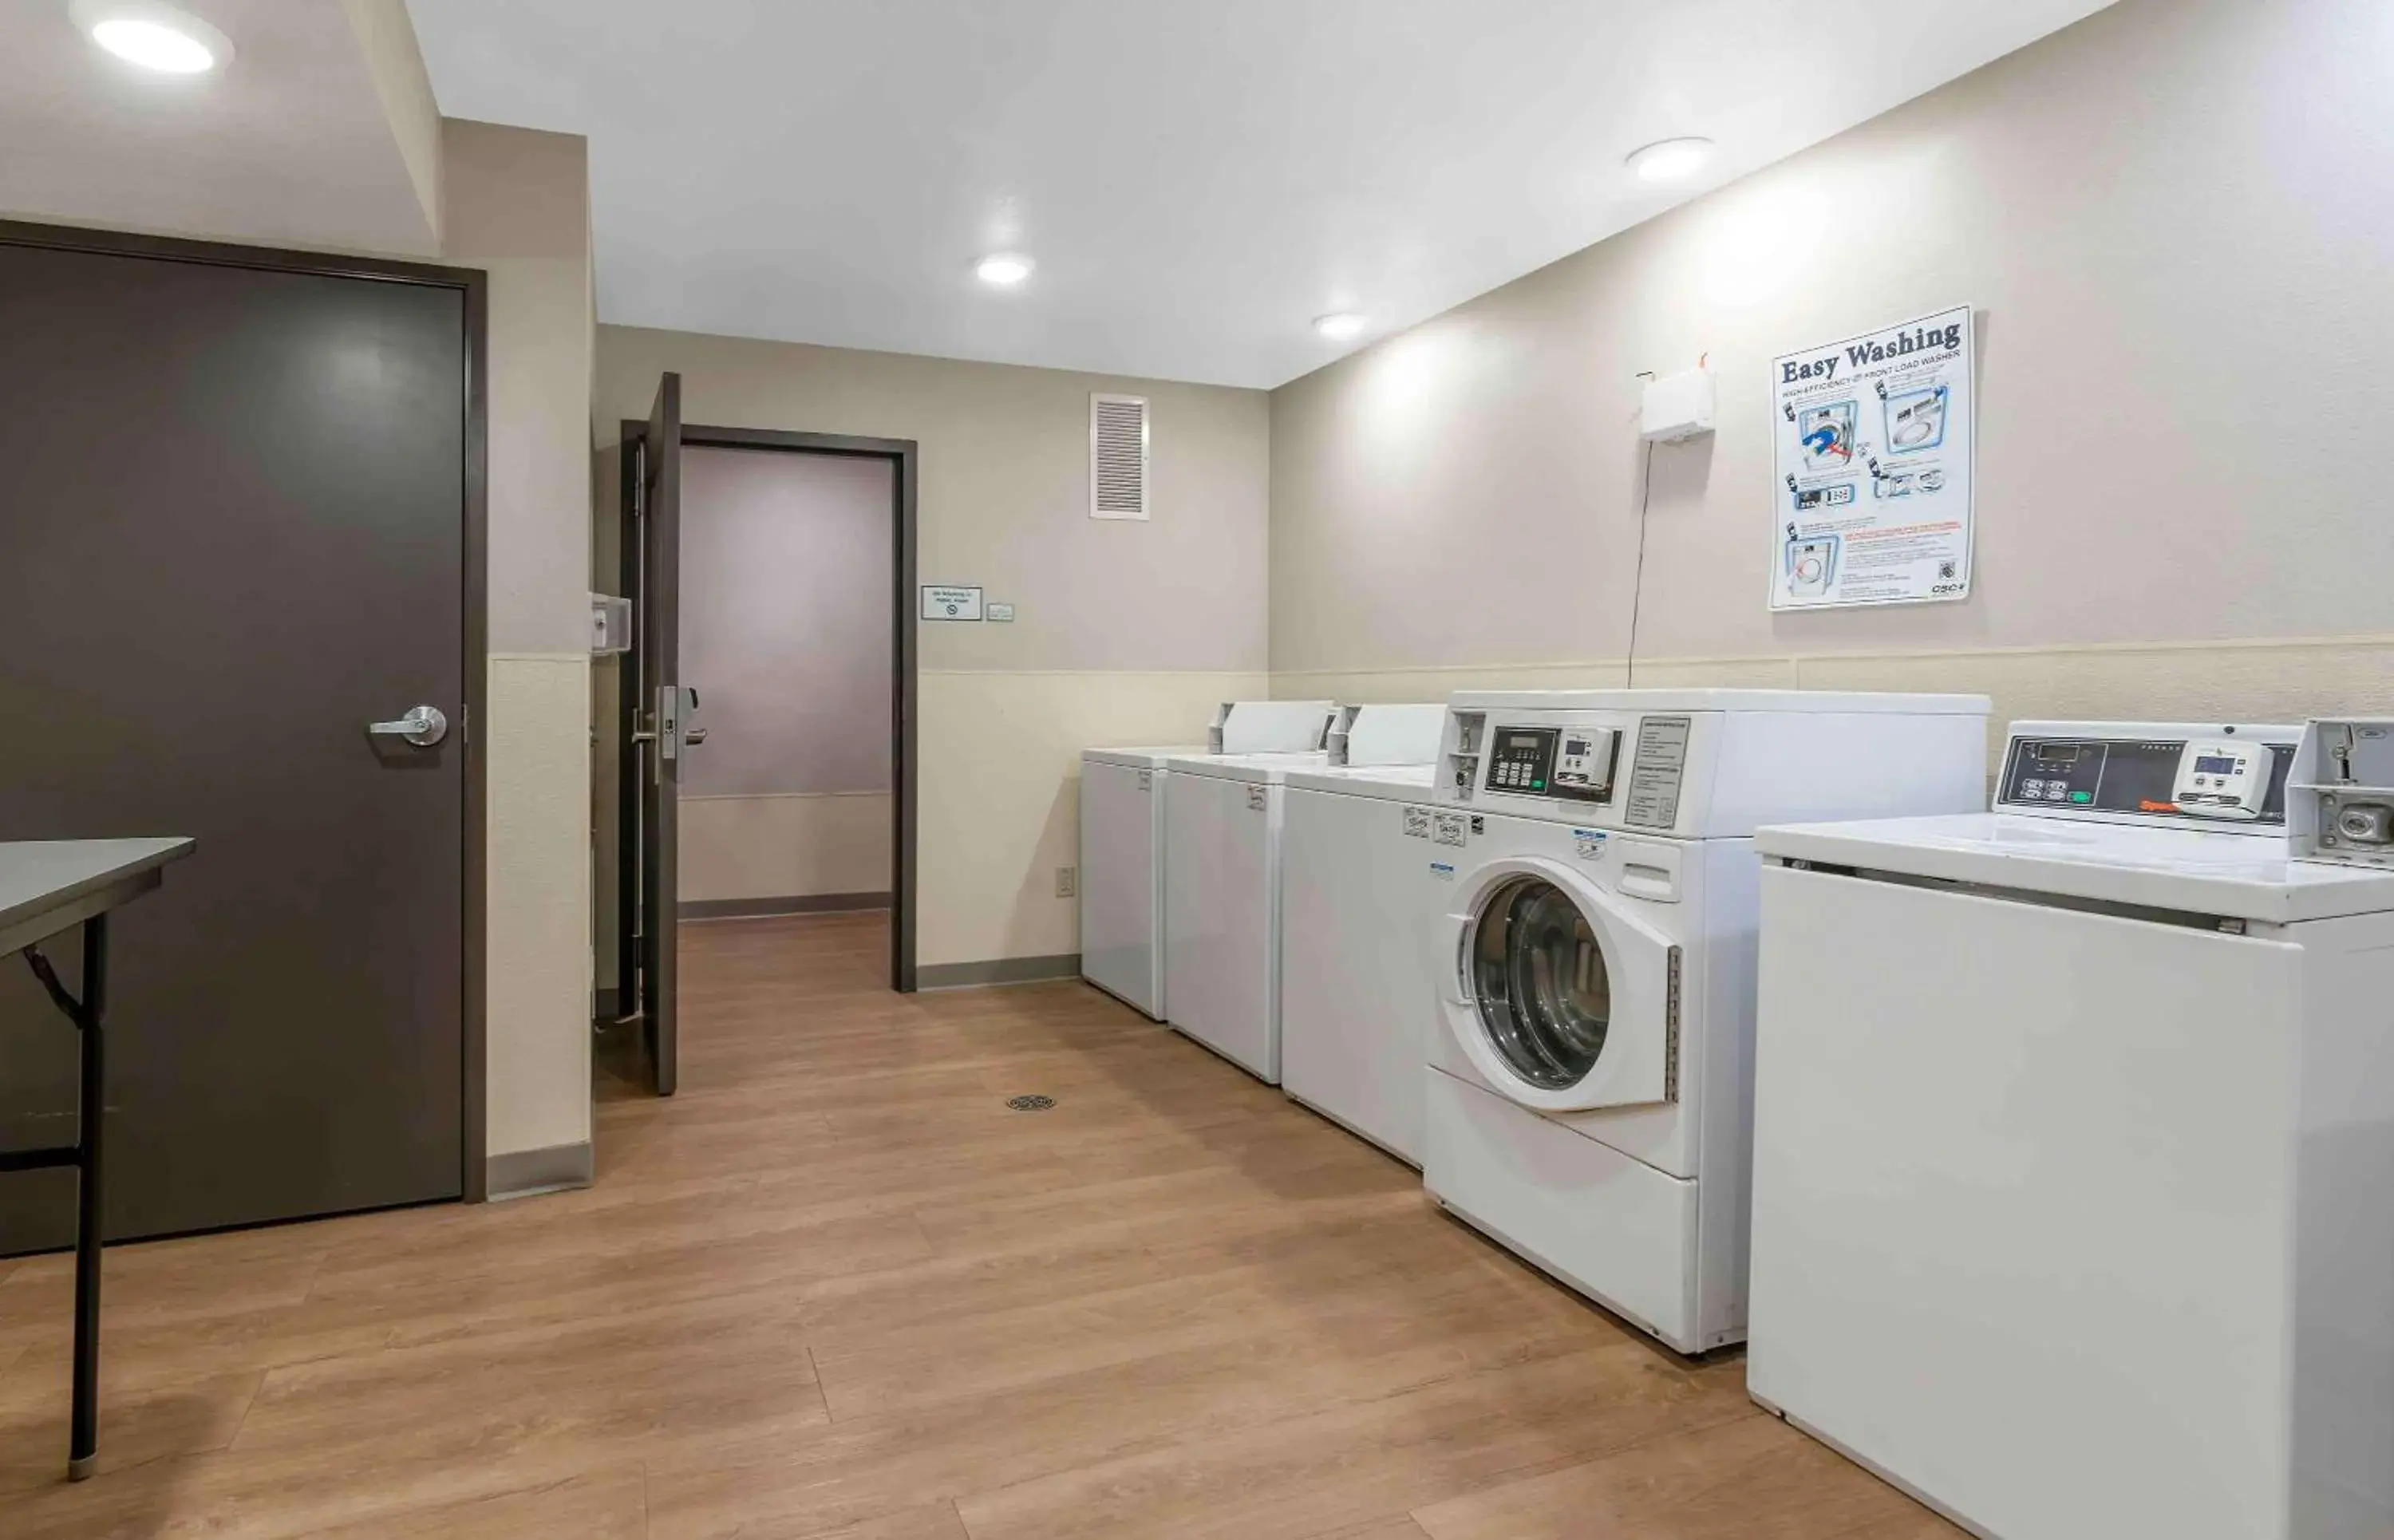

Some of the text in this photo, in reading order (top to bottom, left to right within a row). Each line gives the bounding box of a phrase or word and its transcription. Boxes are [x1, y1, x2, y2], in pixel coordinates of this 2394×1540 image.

[1781, 323, 1961, 383] Easy Washing
[1894, 360, 1919, 373] LOAD
[1921, 349, 1961, 365] WASHER
